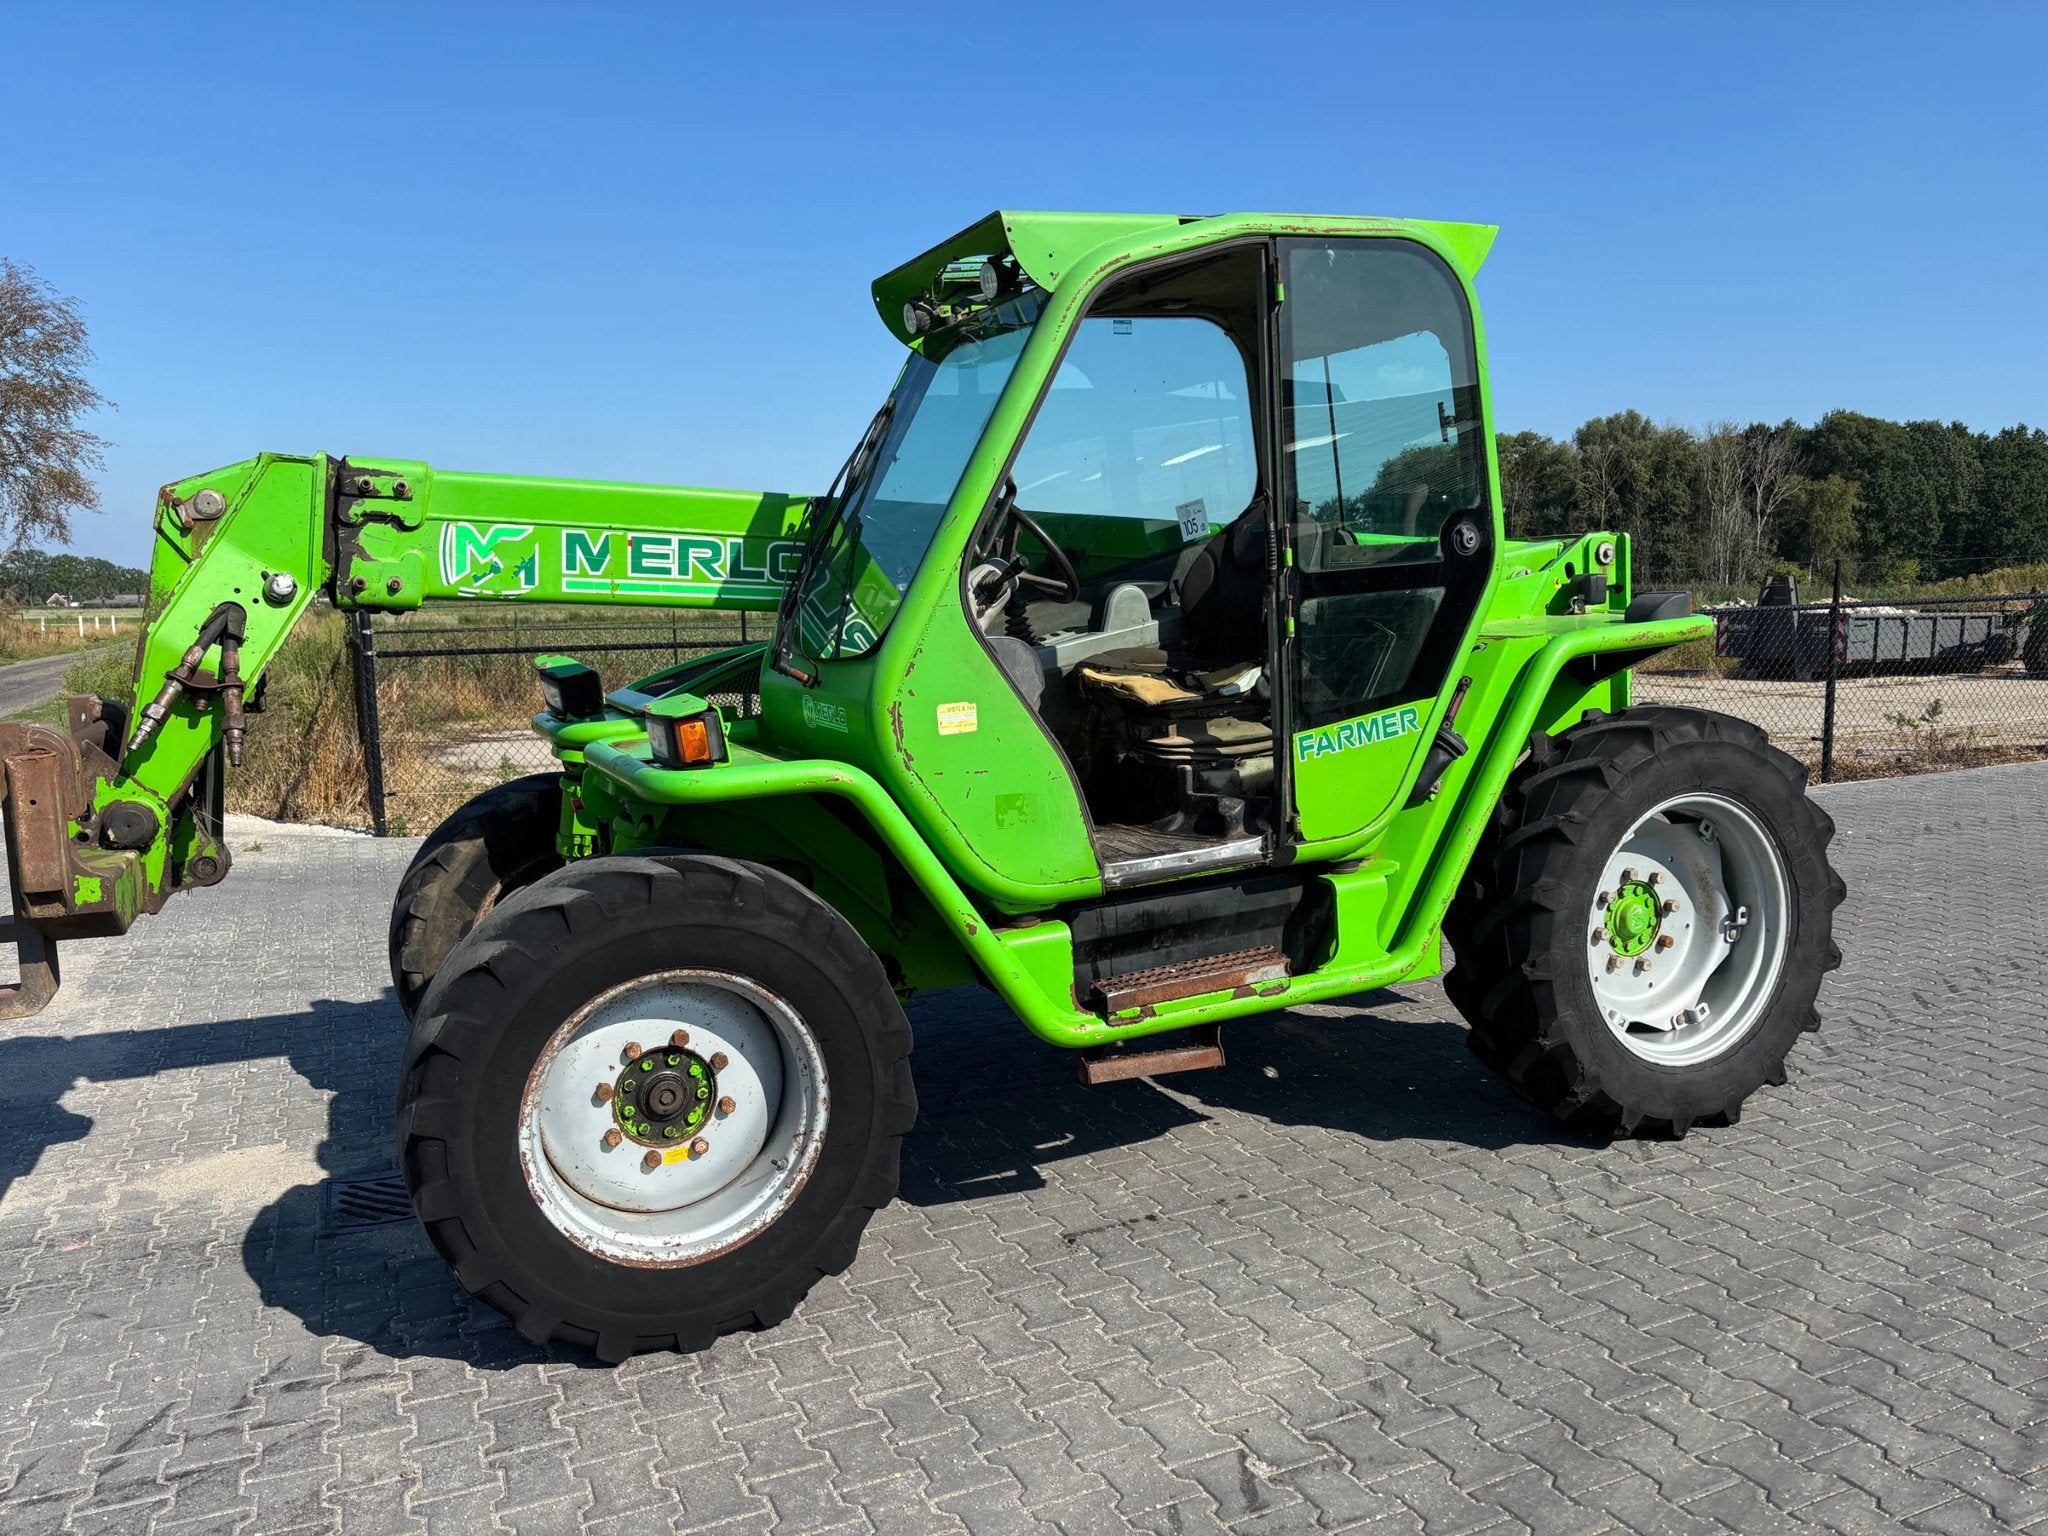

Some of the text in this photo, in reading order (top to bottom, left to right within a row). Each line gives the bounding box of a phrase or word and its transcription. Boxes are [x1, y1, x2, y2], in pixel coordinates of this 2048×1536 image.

[1182, 517, 1199, 536] 105
[561, 529, 806, 584] MERLO
[1297, 706, 1423, 762] FARMER
